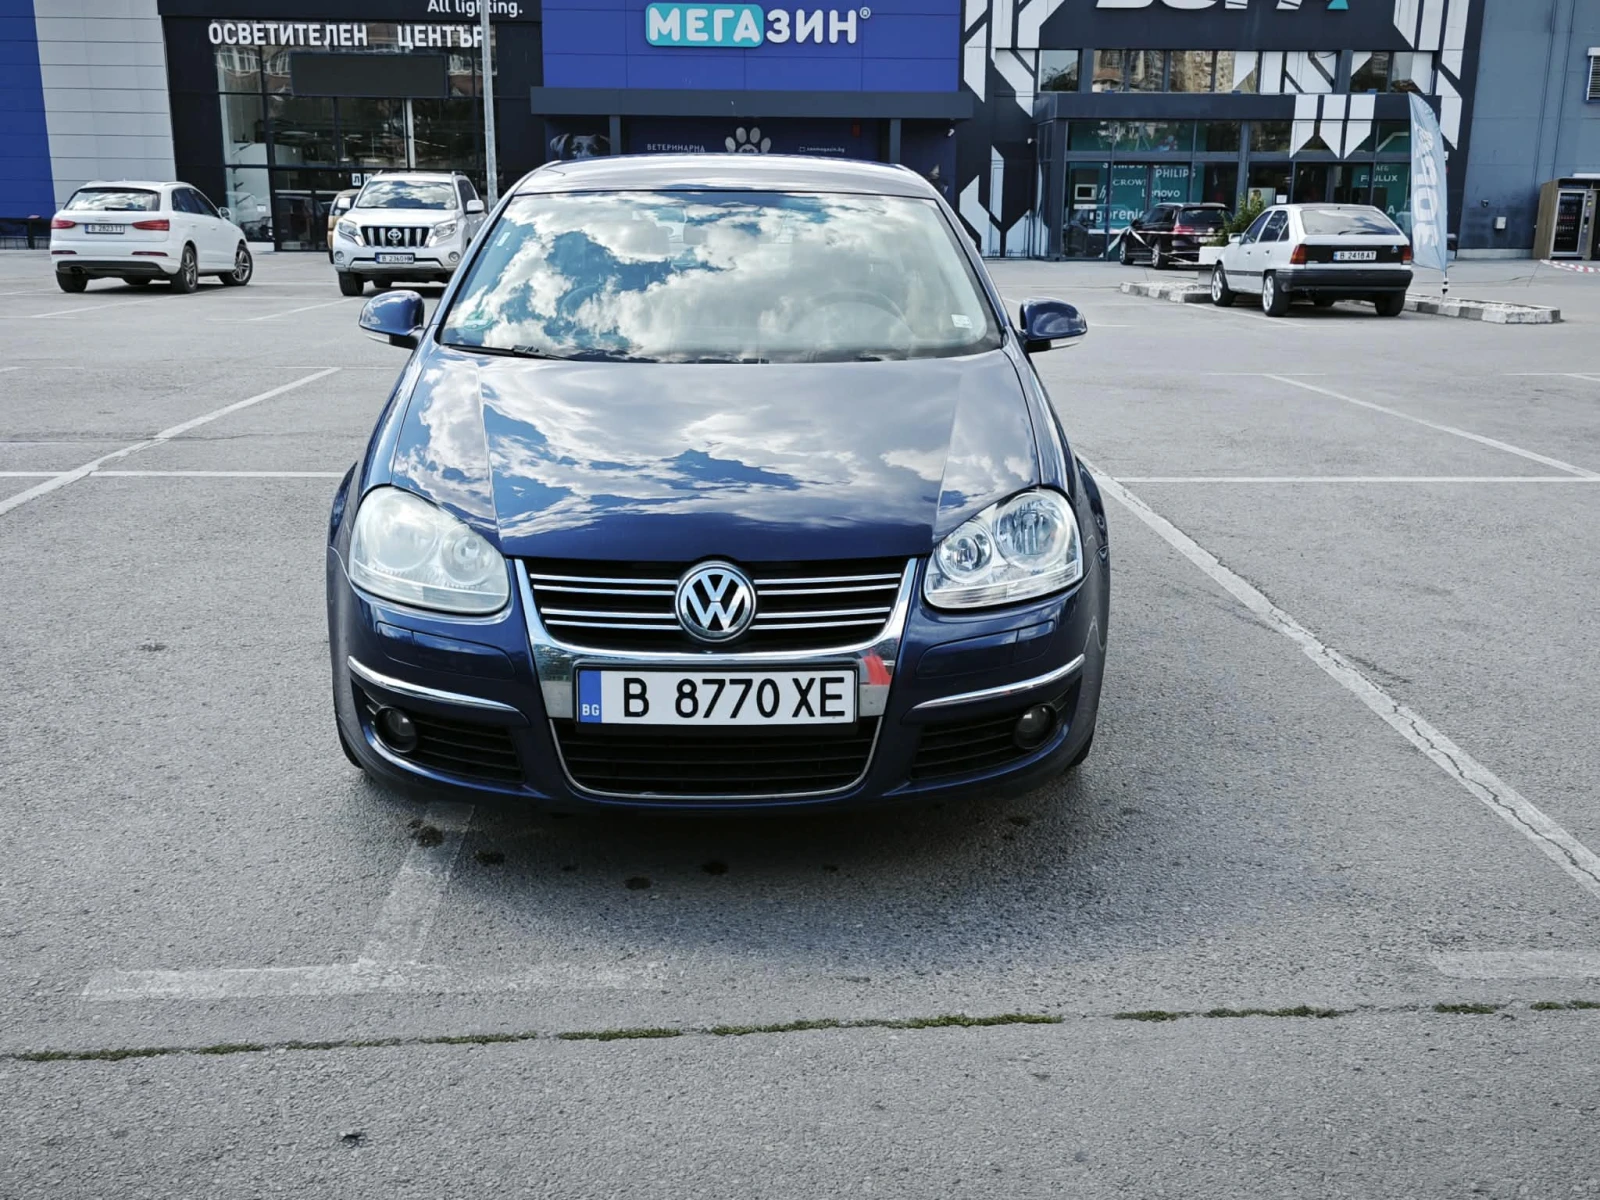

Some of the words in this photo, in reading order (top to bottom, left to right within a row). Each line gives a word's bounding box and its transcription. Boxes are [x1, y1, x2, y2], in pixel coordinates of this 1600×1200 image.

[427, 0, 451, 12] All
[208, 22, 368, 47] ОСВЕТИТЕЛЕН
[397, 24, 483, 49] ЦЕНТЪР
[1142, 188, 1181, 198] Lnovo
[582, 704, 600, 717] BG
[623, 678, 650, 718] B
[675, 678, 780, 719] 8770
[792, 677, 845, 718] XE
